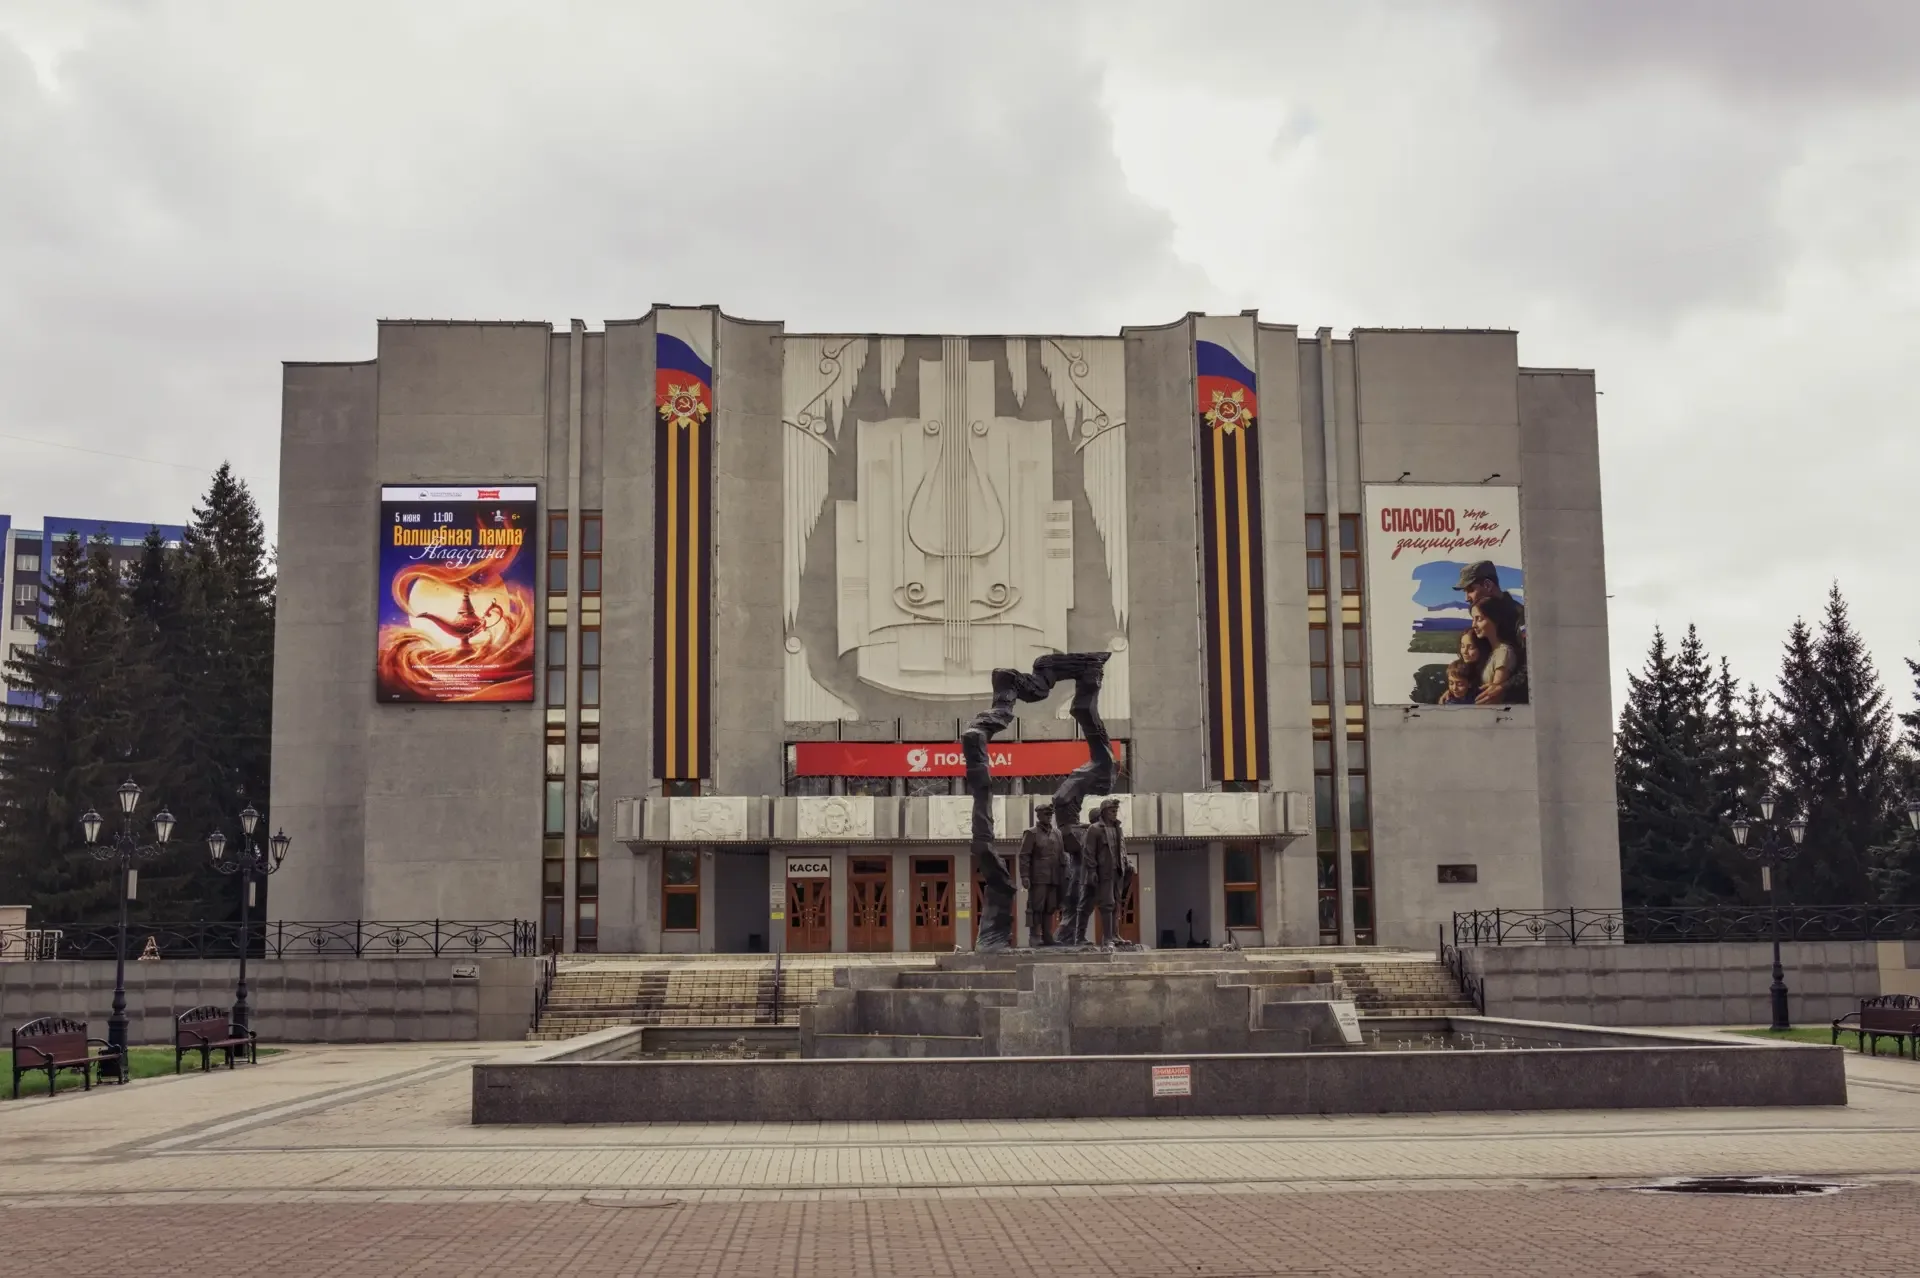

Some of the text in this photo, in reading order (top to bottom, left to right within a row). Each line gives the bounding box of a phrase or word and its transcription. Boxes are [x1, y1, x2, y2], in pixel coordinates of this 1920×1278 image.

[395, 512, 454, 523] 5 июня 11:00
[1381, 508, 1460, 536] СПАСИБО,
[1469, 522, 1500, 531] нас
[393, 525, 523, 546] Волшебная лампа
[1391, 528, 1511, 560] защищаете!
[409, 537, 506, 569] Аладдина
[906, 747, 928, 772] 9
[934, 752, 1012, 767] ПОБДА!
[789, 864, 828, 872] КАССА
